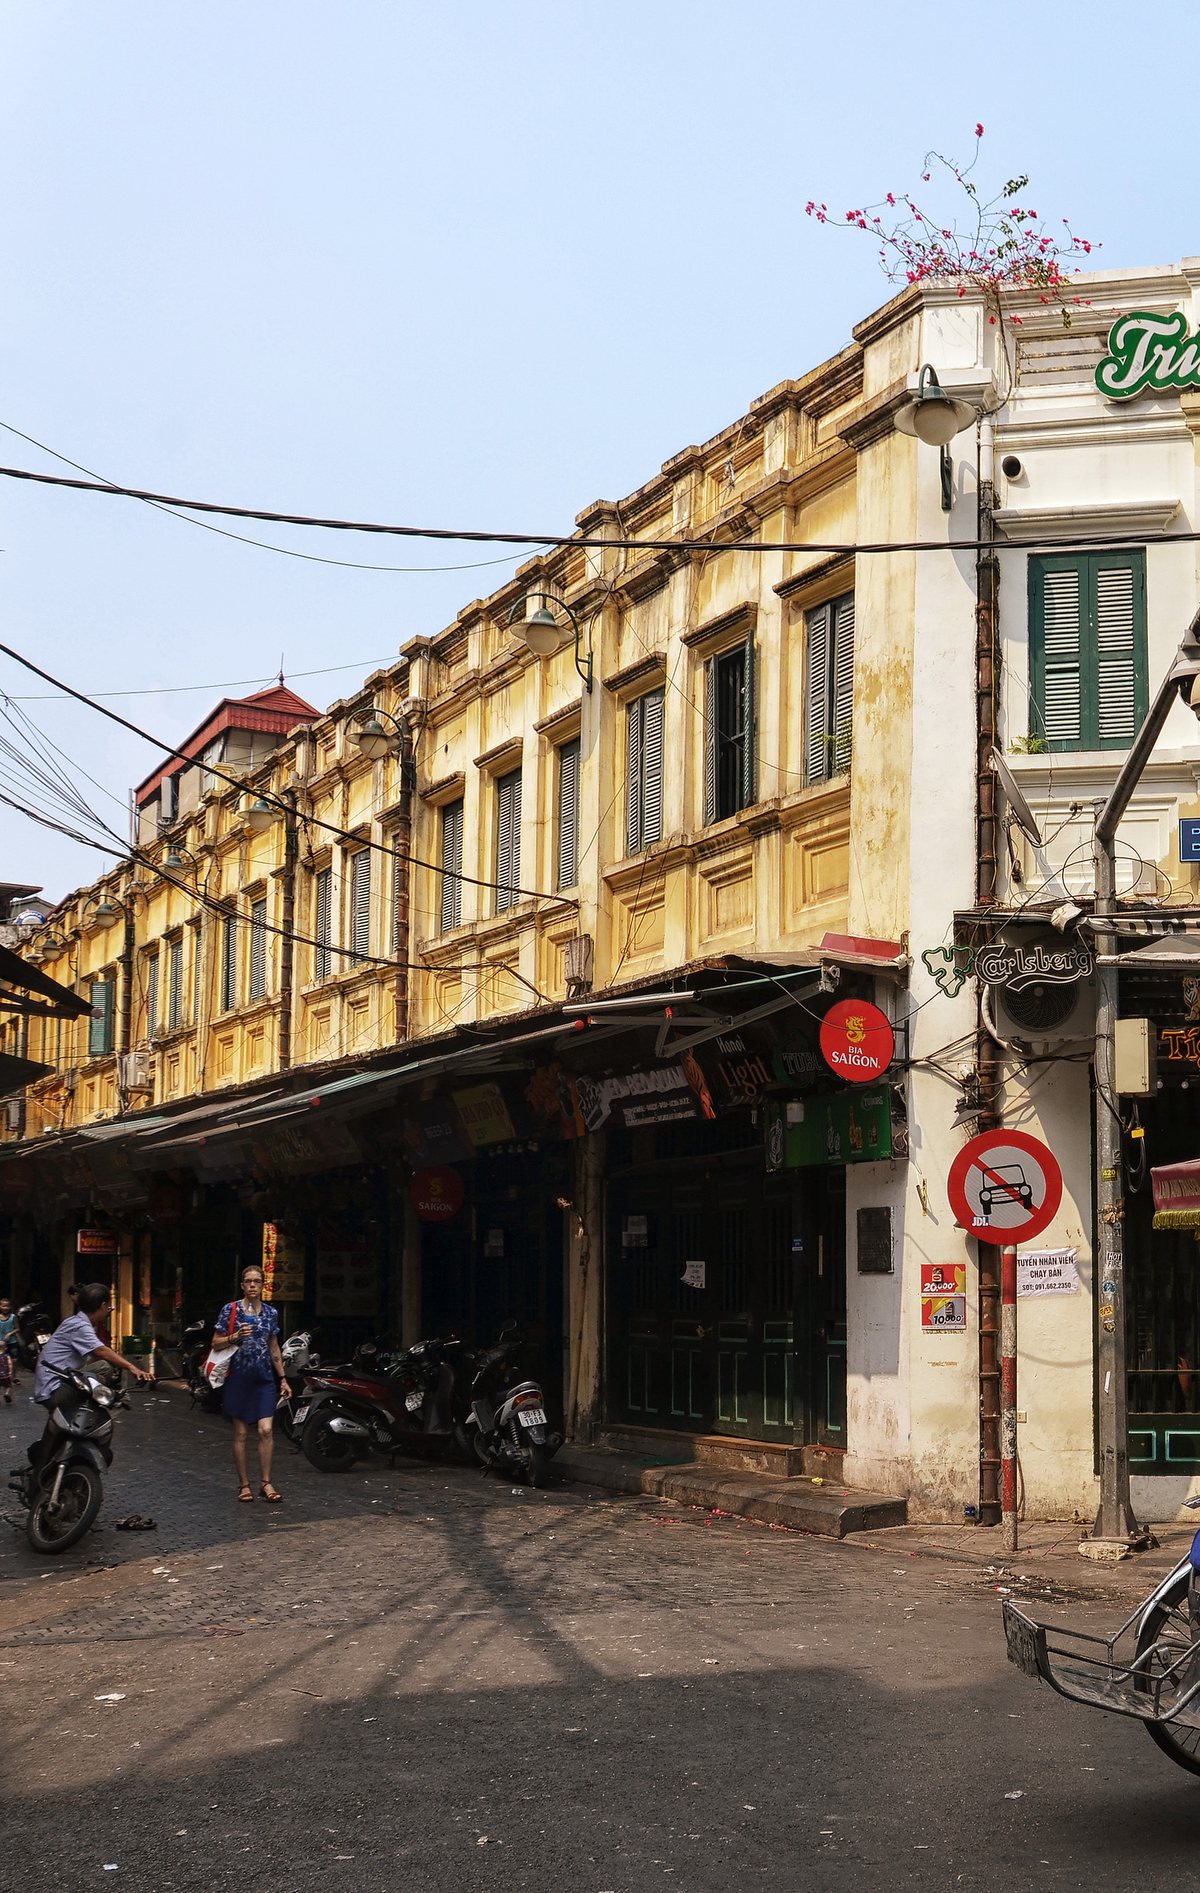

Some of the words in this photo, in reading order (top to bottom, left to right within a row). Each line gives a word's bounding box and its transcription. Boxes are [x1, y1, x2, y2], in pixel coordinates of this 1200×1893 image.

[974, 943, 1093, 993] Carlsberg
[716, 1033, 746, 1054] Hanoi
[848, 1046, 863, 1055] BIA
[831, 1051, 879, 1069] SAIGON
[718, 1056, 772, 1097] Light
[418, 1201, 453, 1212] SAIGON
[1059, 1254, 1074, 1264] VIÊN
[1030, 1269, 1047, 1280] CHẠY
[1048, 1267, 1062, 1277] BÀN
